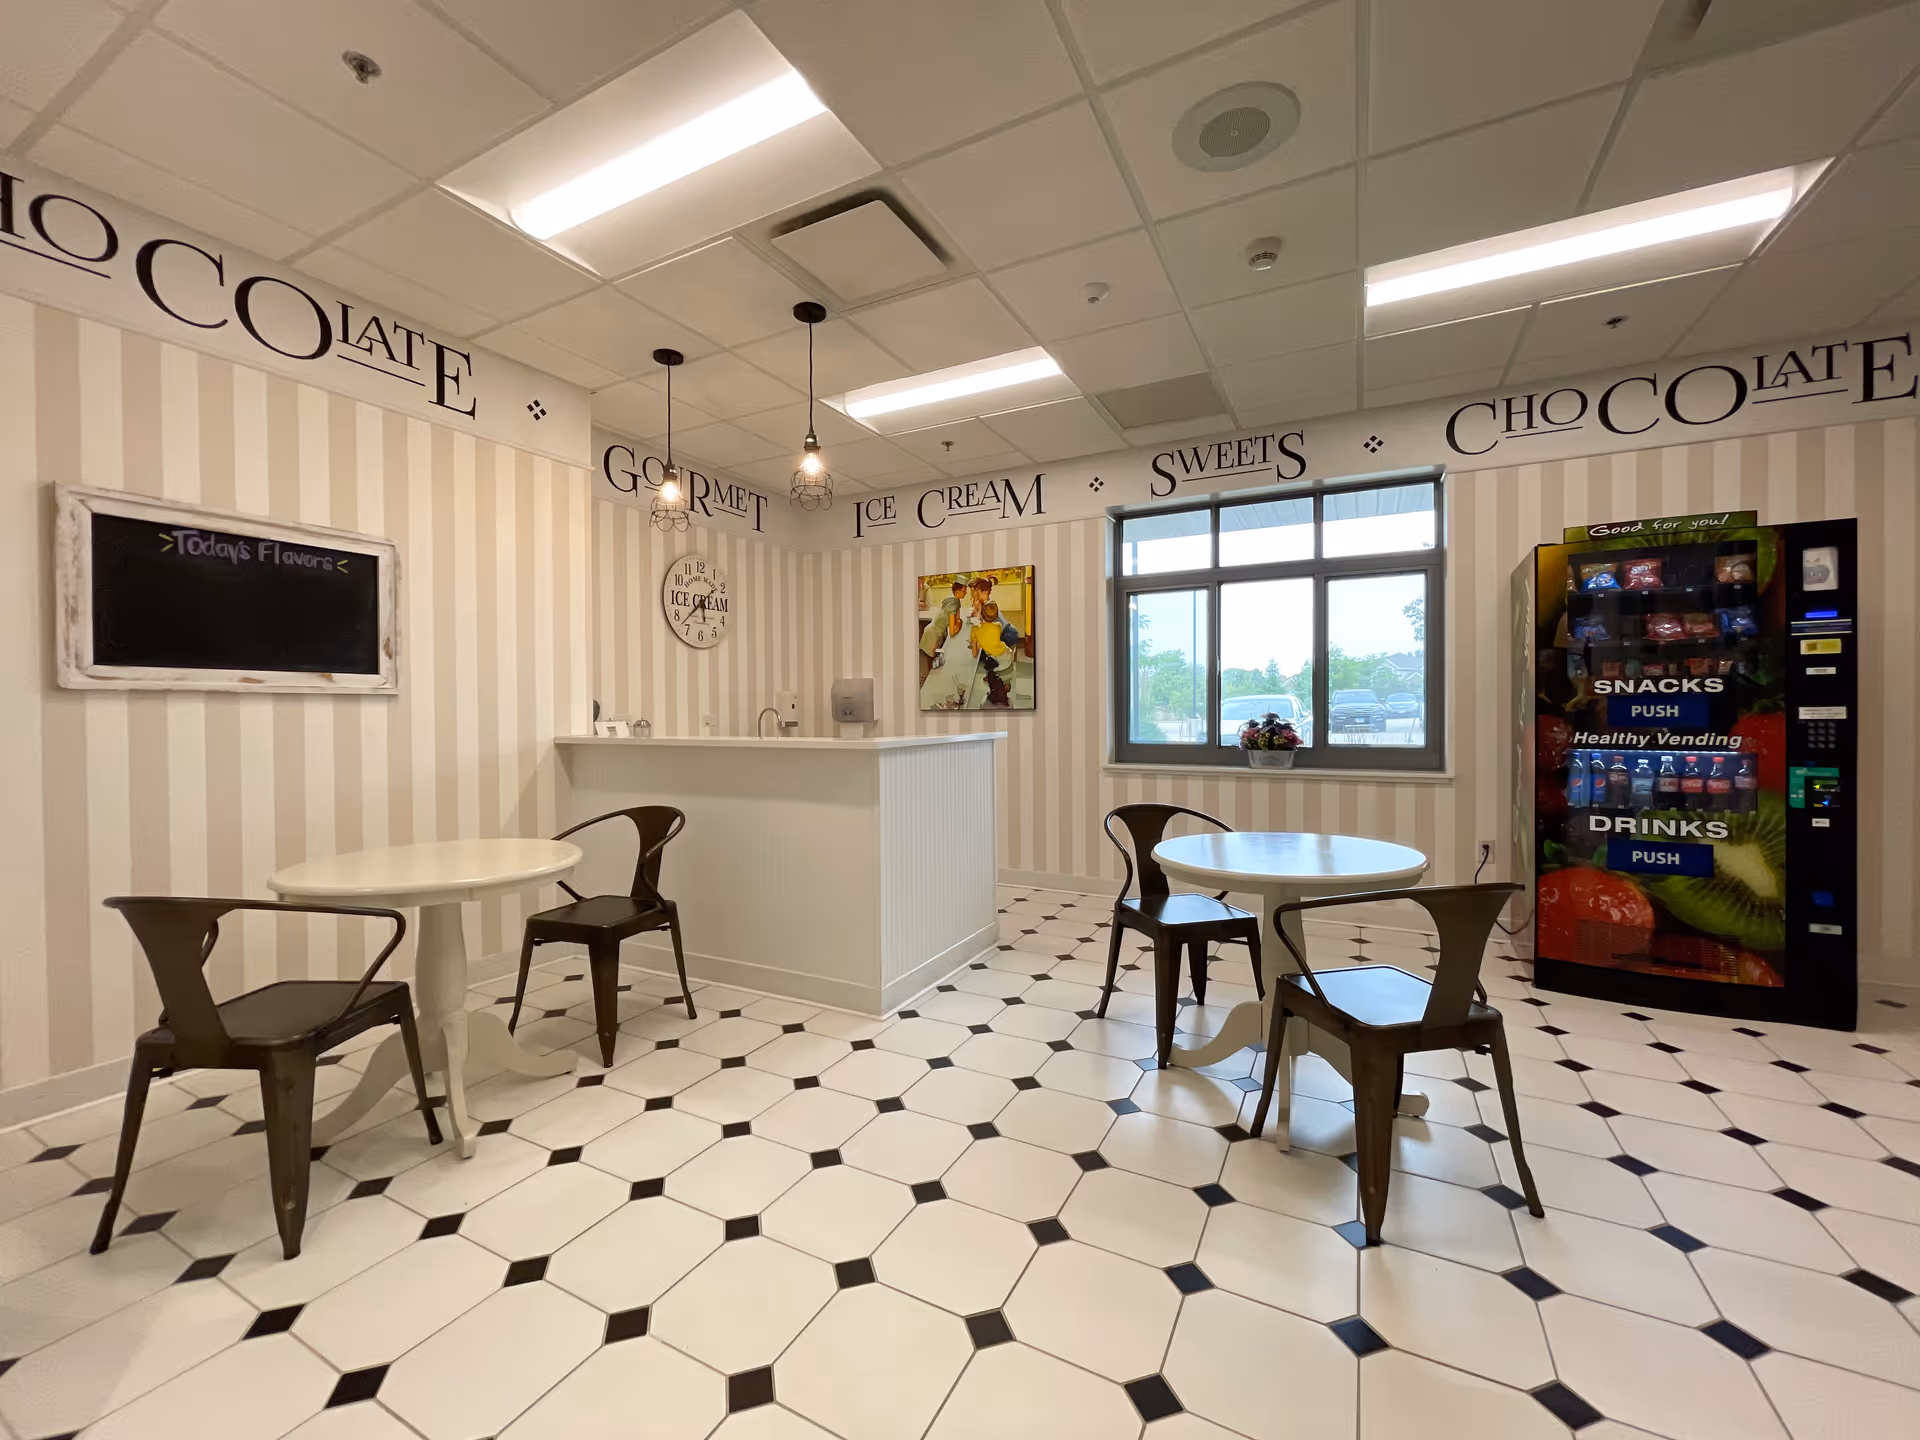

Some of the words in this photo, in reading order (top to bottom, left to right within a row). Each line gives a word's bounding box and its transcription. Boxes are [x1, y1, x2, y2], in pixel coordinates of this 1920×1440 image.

[1445, 332, 1919, 456] CHOCOLATE
[1150, 430, 1308, 500] SWEETS
[853, 495, 897, 538] ICE
[916, 473, 1046, 528] CREAM
[1589, 522, 1645, 536] Good
[1652, 519, 1683, 530] for
[1688, 513, 1730, 530] you!
[258, 541, 334, 571] Flavors
[684, 563, 692, 576] 11
[696, 561, 705, 574] 12
[674, 573, 684, 586] 10
[684, 575, 701, 588] HOME
[720, 582, 726, 594] 2
[671, 590, 690, 607] ICE
[692, 594, 728, 612] CREAM
[674, 609, 680, 622] 8
[720, 615, 726, 627] 4
[684, 624, 690, 636] 7
[698, 630, 704, 641] 6
[711, 626, 717, 638] 5
[1593, 677, 1724, 694] SNACKS
[1631, 705, 1679, 718] PUSH
[1573, 731, 1651, 748] Healthy
[1657, 732, 1743, 749] Vending
[1589, 815, 1729, 839] DRINKS
[1632, 850, 1680, 865] PUSH
